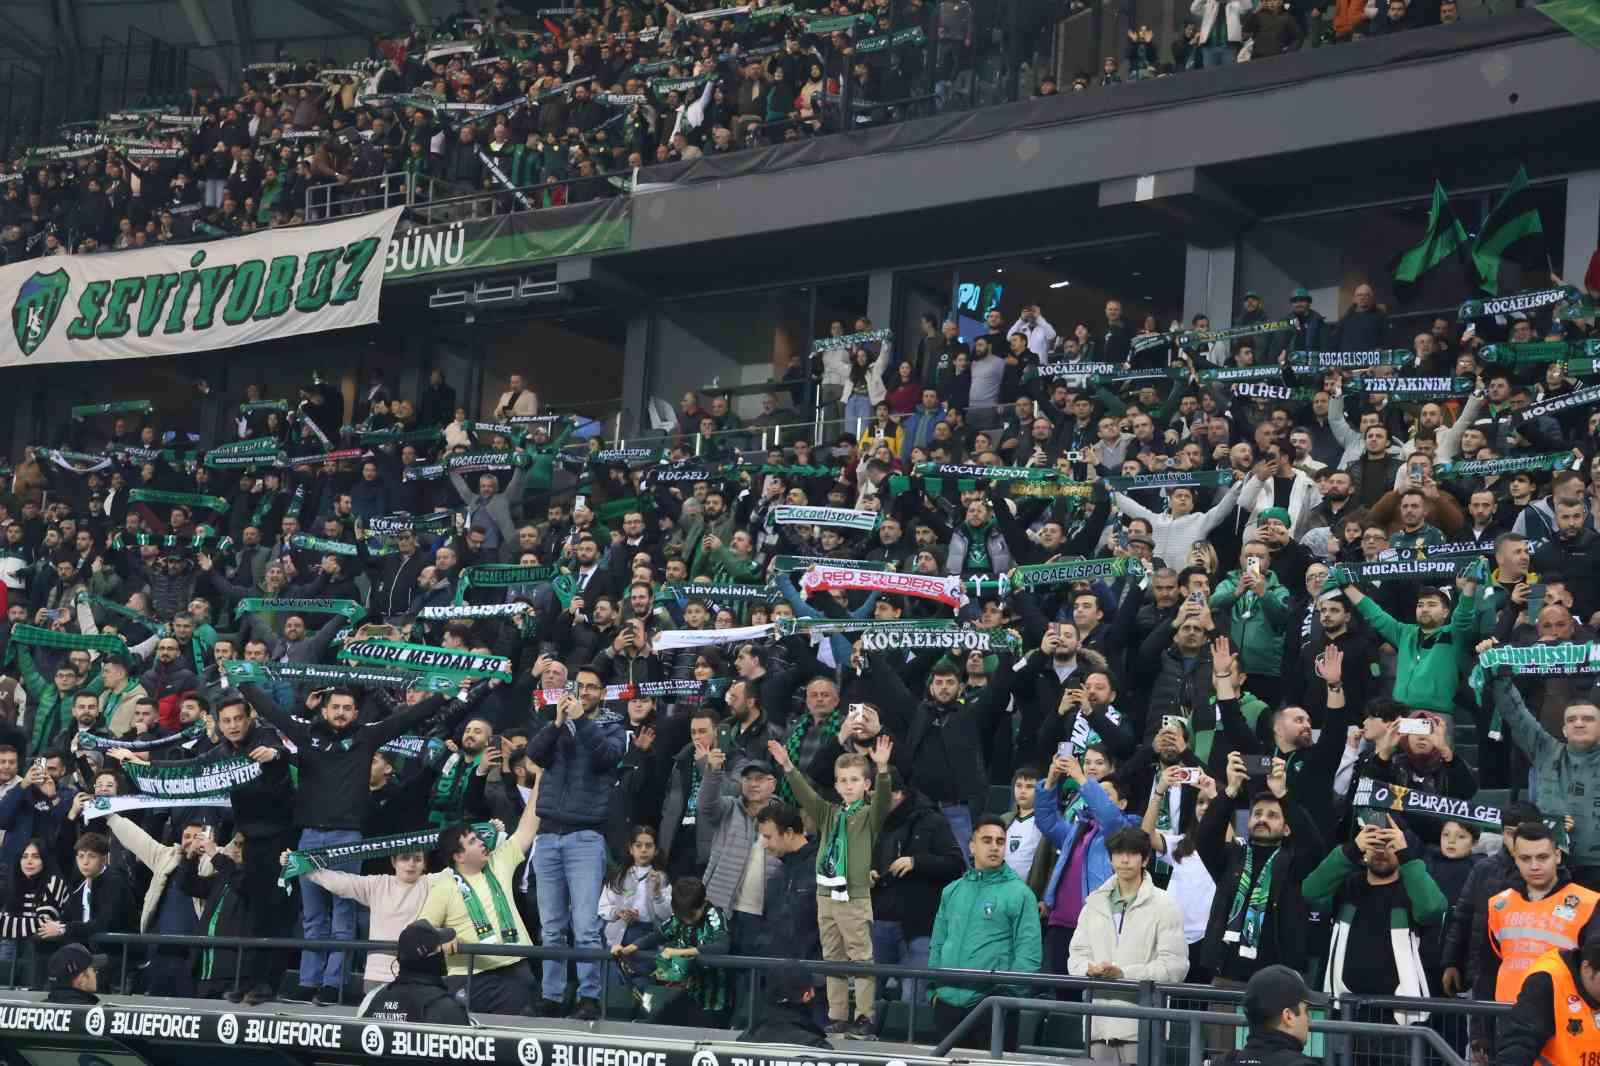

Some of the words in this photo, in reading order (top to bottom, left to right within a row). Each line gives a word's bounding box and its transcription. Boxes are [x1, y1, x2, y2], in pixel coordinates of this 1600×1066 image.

[822, 571, 854, 583] RED
[406, 649, 474, 672] MEYDAN
[479, 656, 502, 673] 89
[1408, 792, 1470, 818] BURAYA
[110, 1012, 201, 1039] BLUEFORCE
[244, 1021, 342, 1048] BLUEFORCE
[391, 1031, 496, 1061] BLUEFORCE
